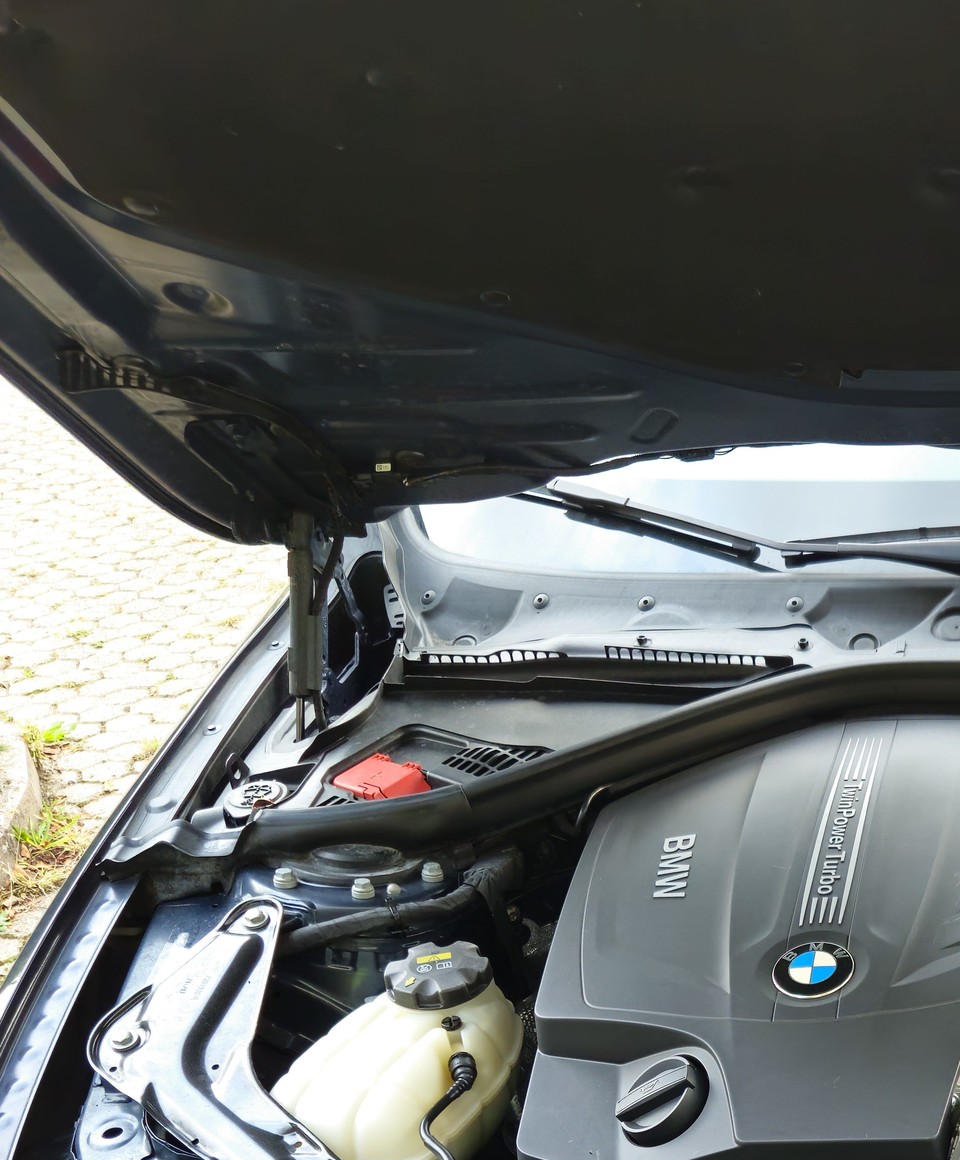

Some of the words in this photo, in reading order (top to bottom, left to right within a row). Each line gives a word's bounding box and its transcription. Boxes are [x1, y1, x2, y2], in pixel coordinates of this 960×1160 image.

[653, 833, 697, 899] BMW
[817, 850, 847, 896] Turbo
[782, 942, 849, 962] BMW
